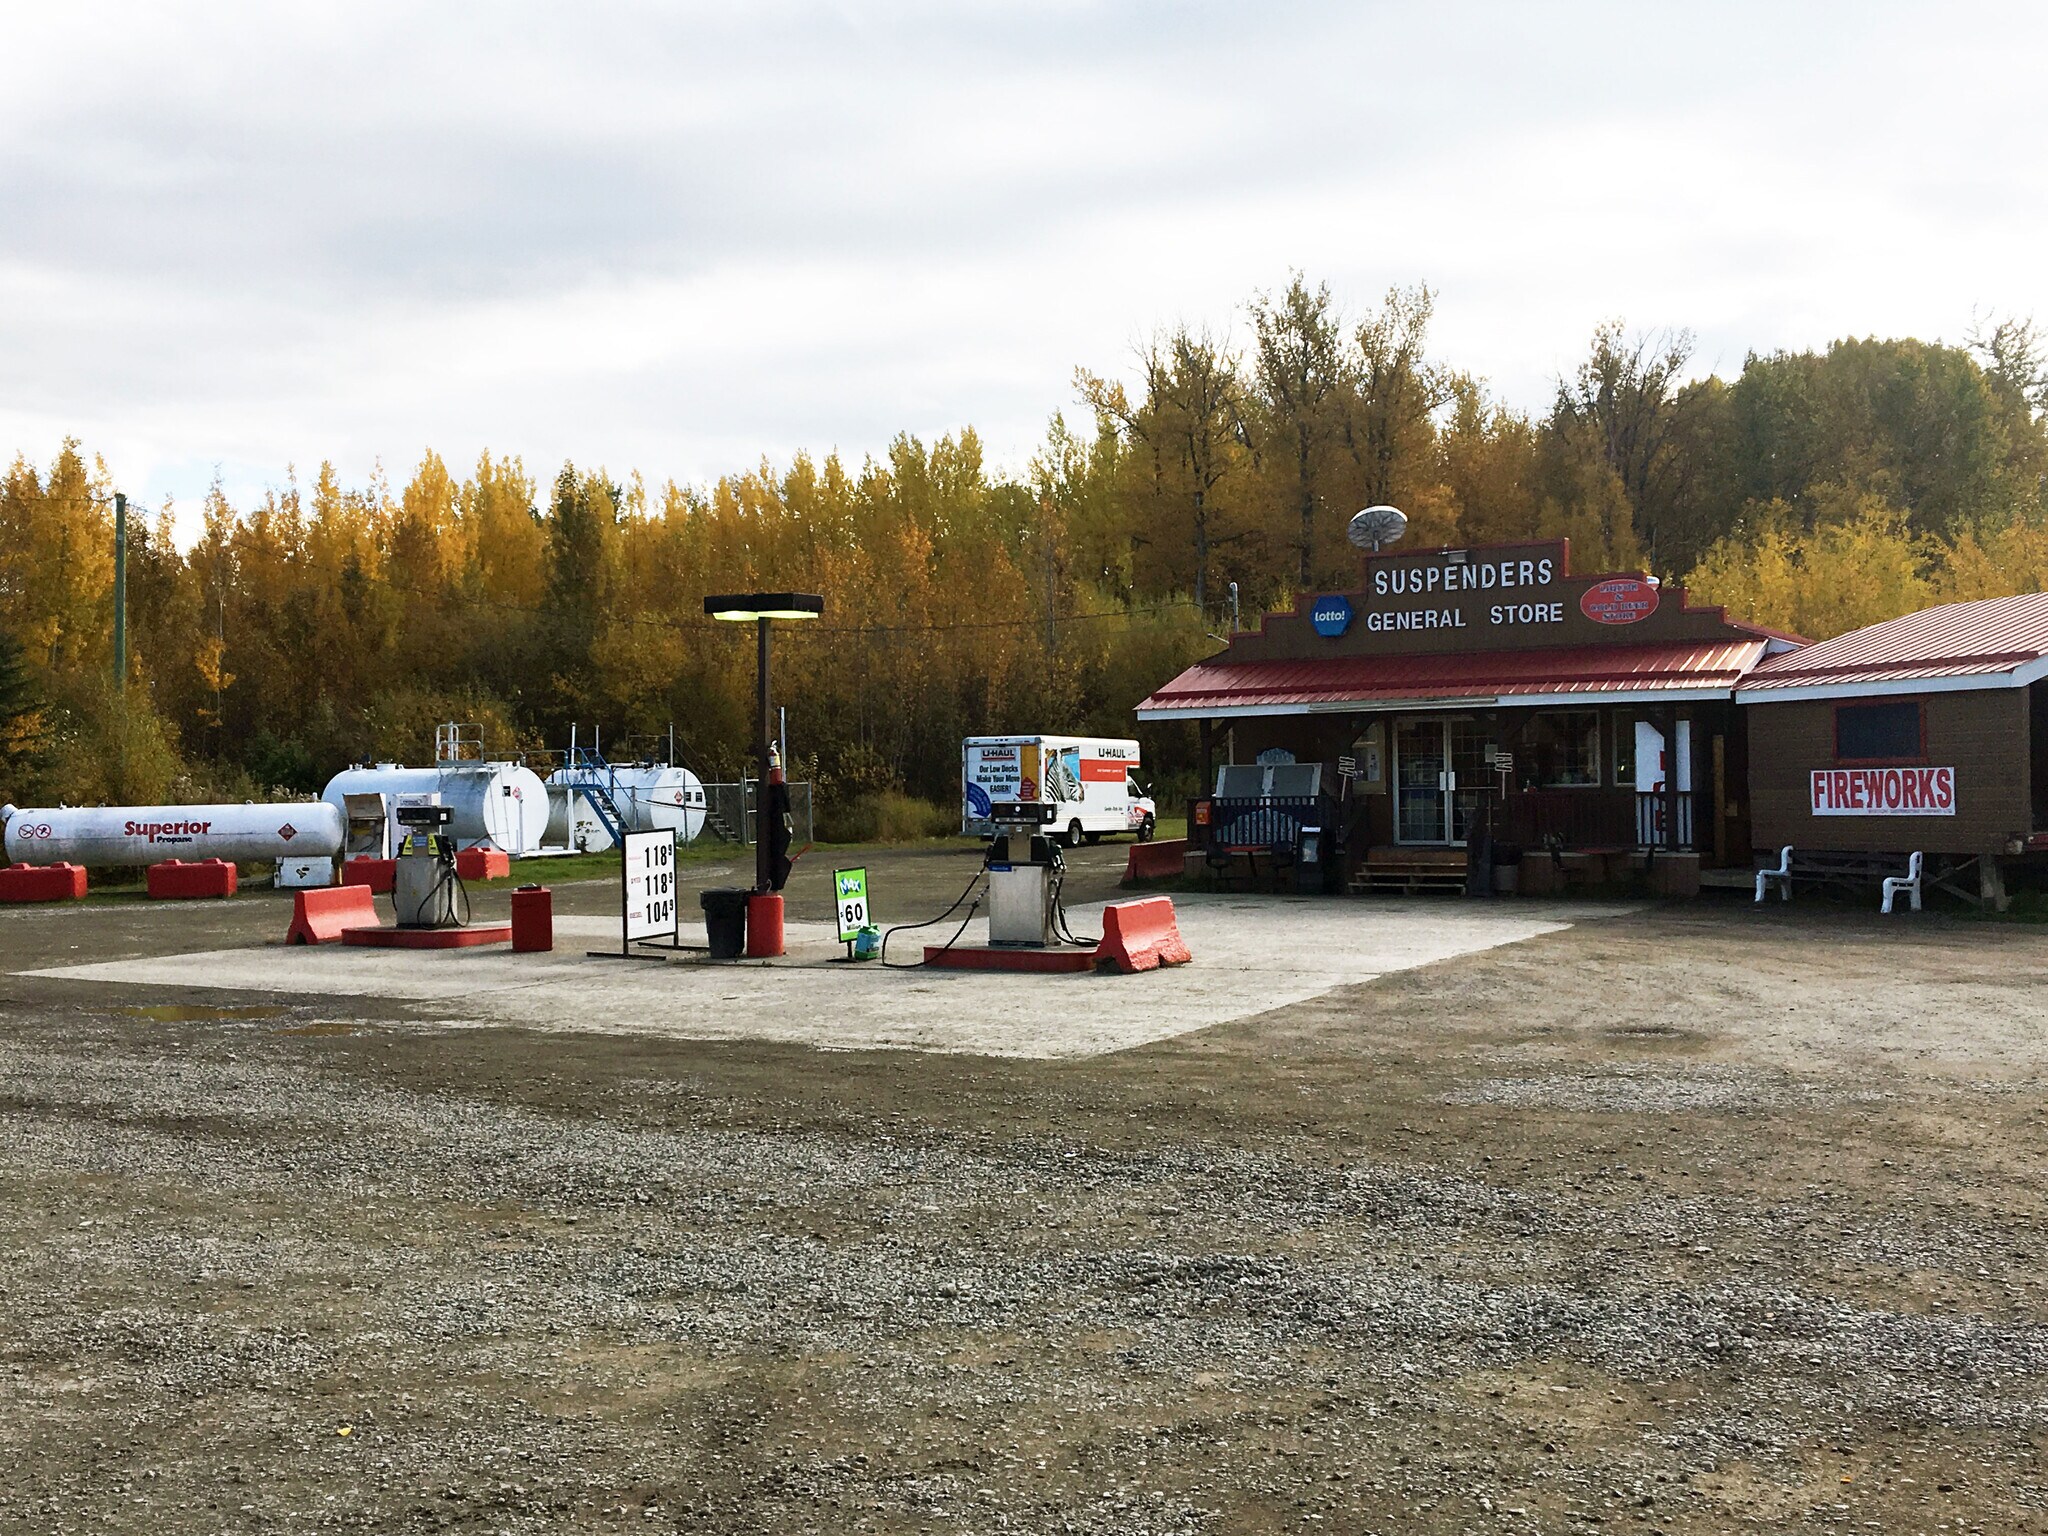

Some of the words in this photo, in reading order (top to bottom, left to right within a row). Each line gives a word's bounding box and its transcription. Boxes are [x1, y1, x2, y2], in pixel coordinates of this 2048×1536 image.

[1374, 558, 1553, 595] SUSPENDERS
[1367, 608, 1466, 631] GENERAL
[1490, 603, 1563, 625] STORE
[982, 749, 1015, 757] U-HAUL
[1098, 747, 1126, 758] U-HAUL
[979, 765, 988, 773] Our
[990, 765, 1000, 773] Low
[1001, 765, 1018, 773] Decks
[989, 784, 1011, 793] EASIER!
[1813, 768, 1952, 809] FIREWORKS
[124, 820, 211, 843] Superior
[156, 836, 192, 844] Propane
[840, 877, 861, 895] MAX
